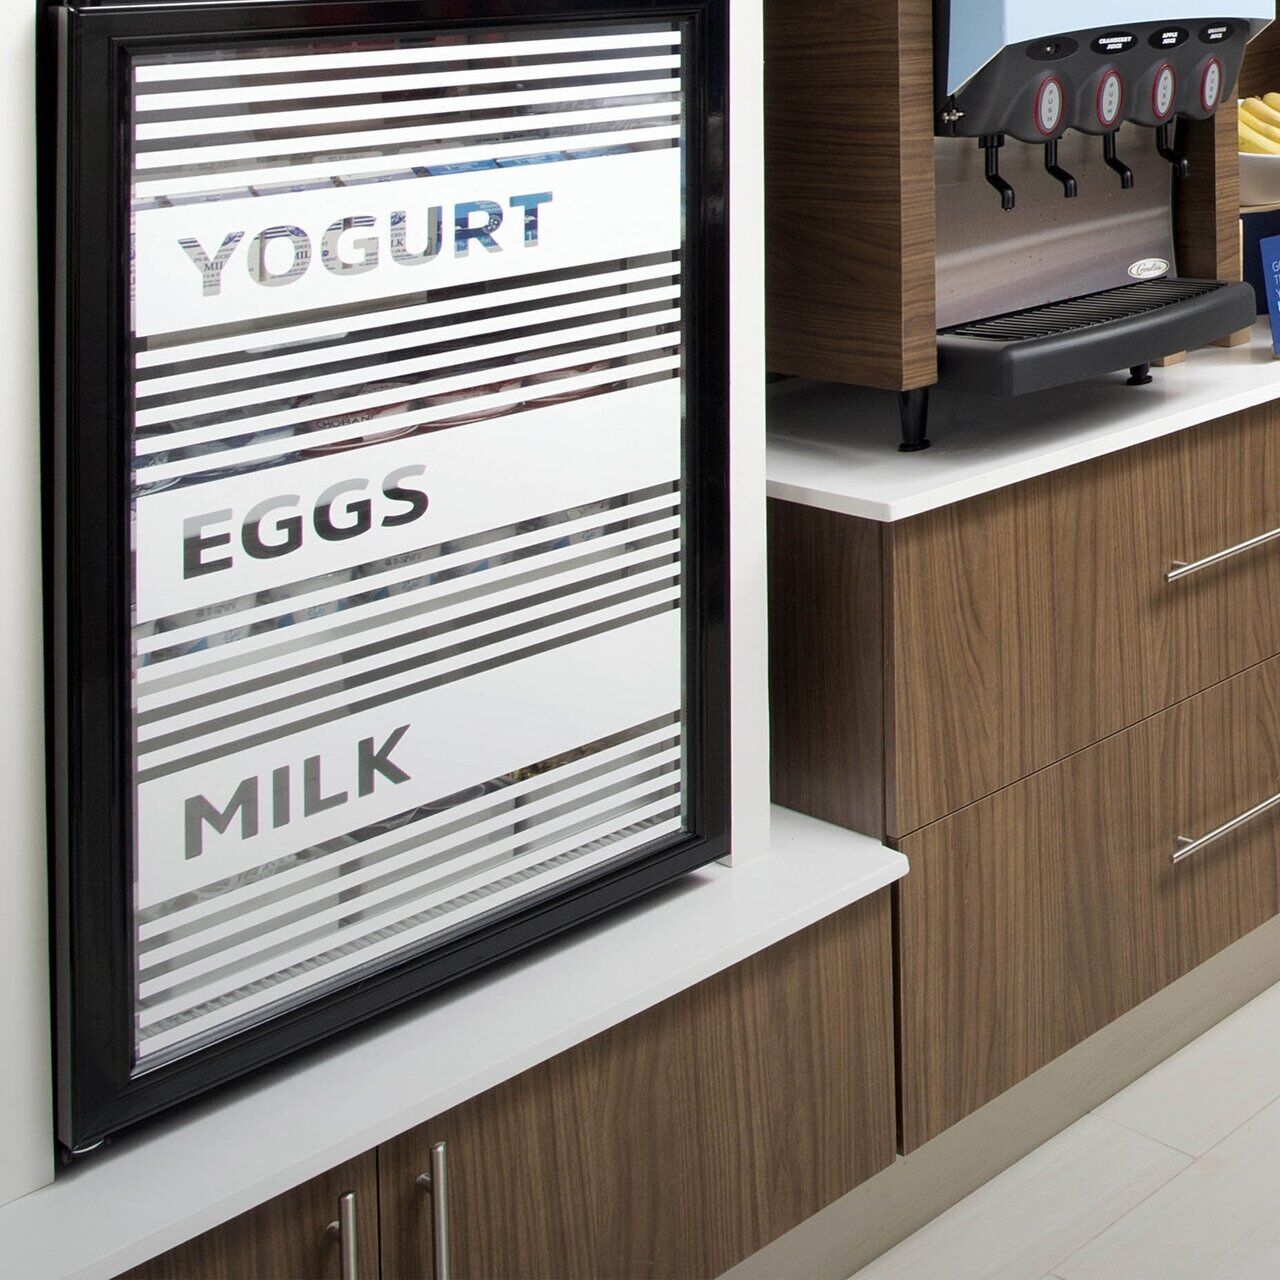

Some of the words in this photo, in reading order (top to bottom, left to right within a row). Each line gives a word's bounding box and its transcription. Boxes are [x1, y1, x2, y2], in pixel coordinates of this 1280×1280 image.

[176, 190, 553, 298] YOGURT
[182, 463, 430, 580] EGGS
[184, 723, 413, 861] MILK
